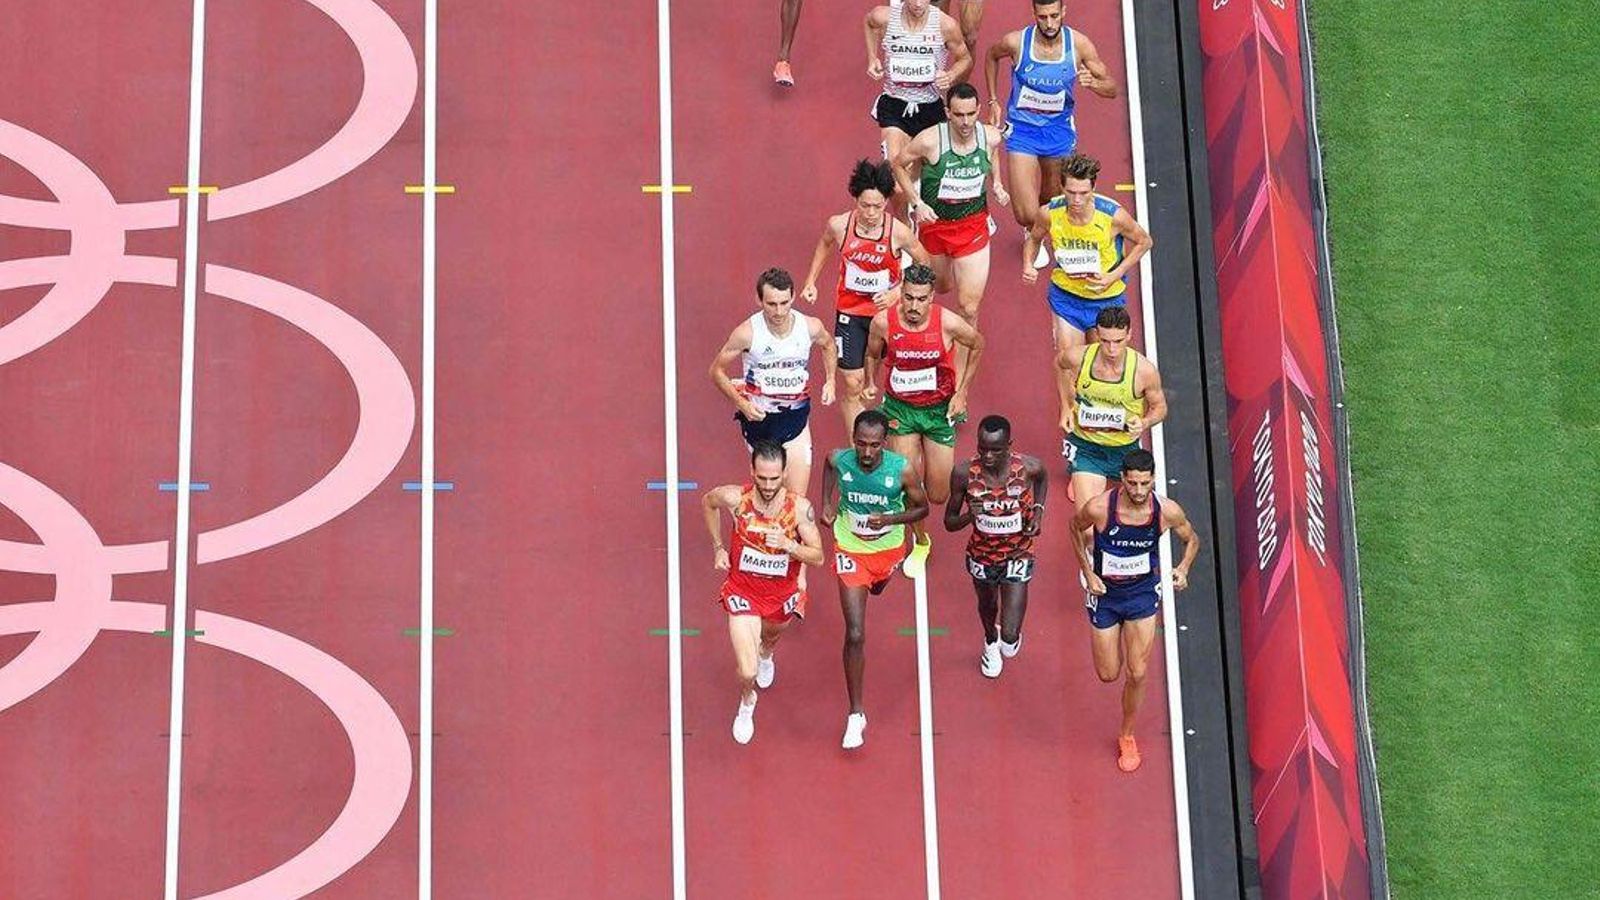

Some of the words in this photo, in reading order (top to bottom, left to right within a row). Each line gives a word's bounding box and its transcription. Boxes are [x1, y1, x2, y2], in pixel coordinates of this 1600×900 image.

[891, 44, 934, 55] CANADA
[892, 64, 932, 76] HUGHES
[1027, 77, 1064, 87] ITALIA
[943, 166, 982, 178] ALGERIA
[848, 251, 884, 265] JAPAN
[854, 276, 878, 287] AOKI
[895, 350, 940, 360] MOROCCO
[764, 375, 804, 388] SEDDON
[1081, 409, 1122, 423] TRIPPAS
[1252, 409, 1275, 509] TOKYO
[847, 491, 889, 506] ETHIOPIA
[982, 499, 1020, 511] ENYA
[1256, 492, 1278, 571] 2020
[1116, 540, 1154, 549] FRANCE
[742, 553, 787, 569] MARTOS
[838, 553, 854, 571] 13
[1010, 559, 1024, 576] 12
[730, 597, 748, 610] 14
